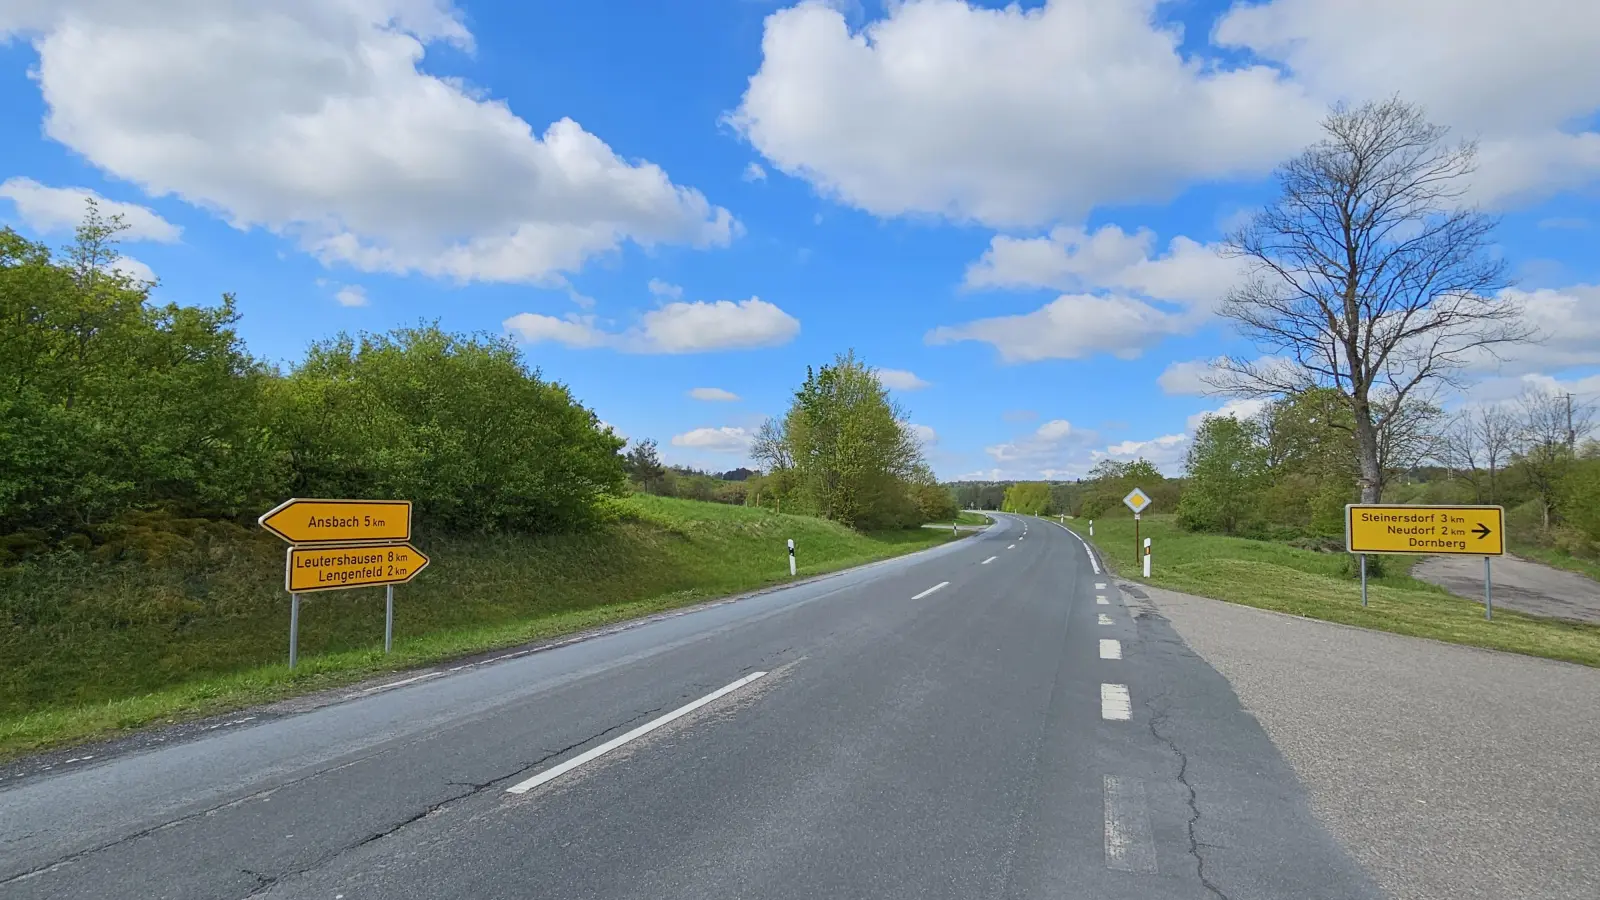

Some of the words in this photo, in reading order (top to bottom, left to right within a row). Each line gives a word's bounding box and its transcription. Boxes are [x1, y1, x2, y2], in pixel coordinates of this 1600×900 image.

[308, 516, 359, 528] Ansbach
[364, 516, 370, 526] 5
[373, 518, 385, 527] km
[1362, 513, 1435, 522] Steinersdorf
[1387, 526, 1435, 535] Neudorf
[1442, 527, 1448, 535] 2
[1410, 538, 1466, 549] Dornberg
[297, 554, 382, 568] Leutershausen
[388, 552, 393, 562] 8
[319, 566, 382, 583] Lengenfeld
[388, 565, 393, 576] 2
